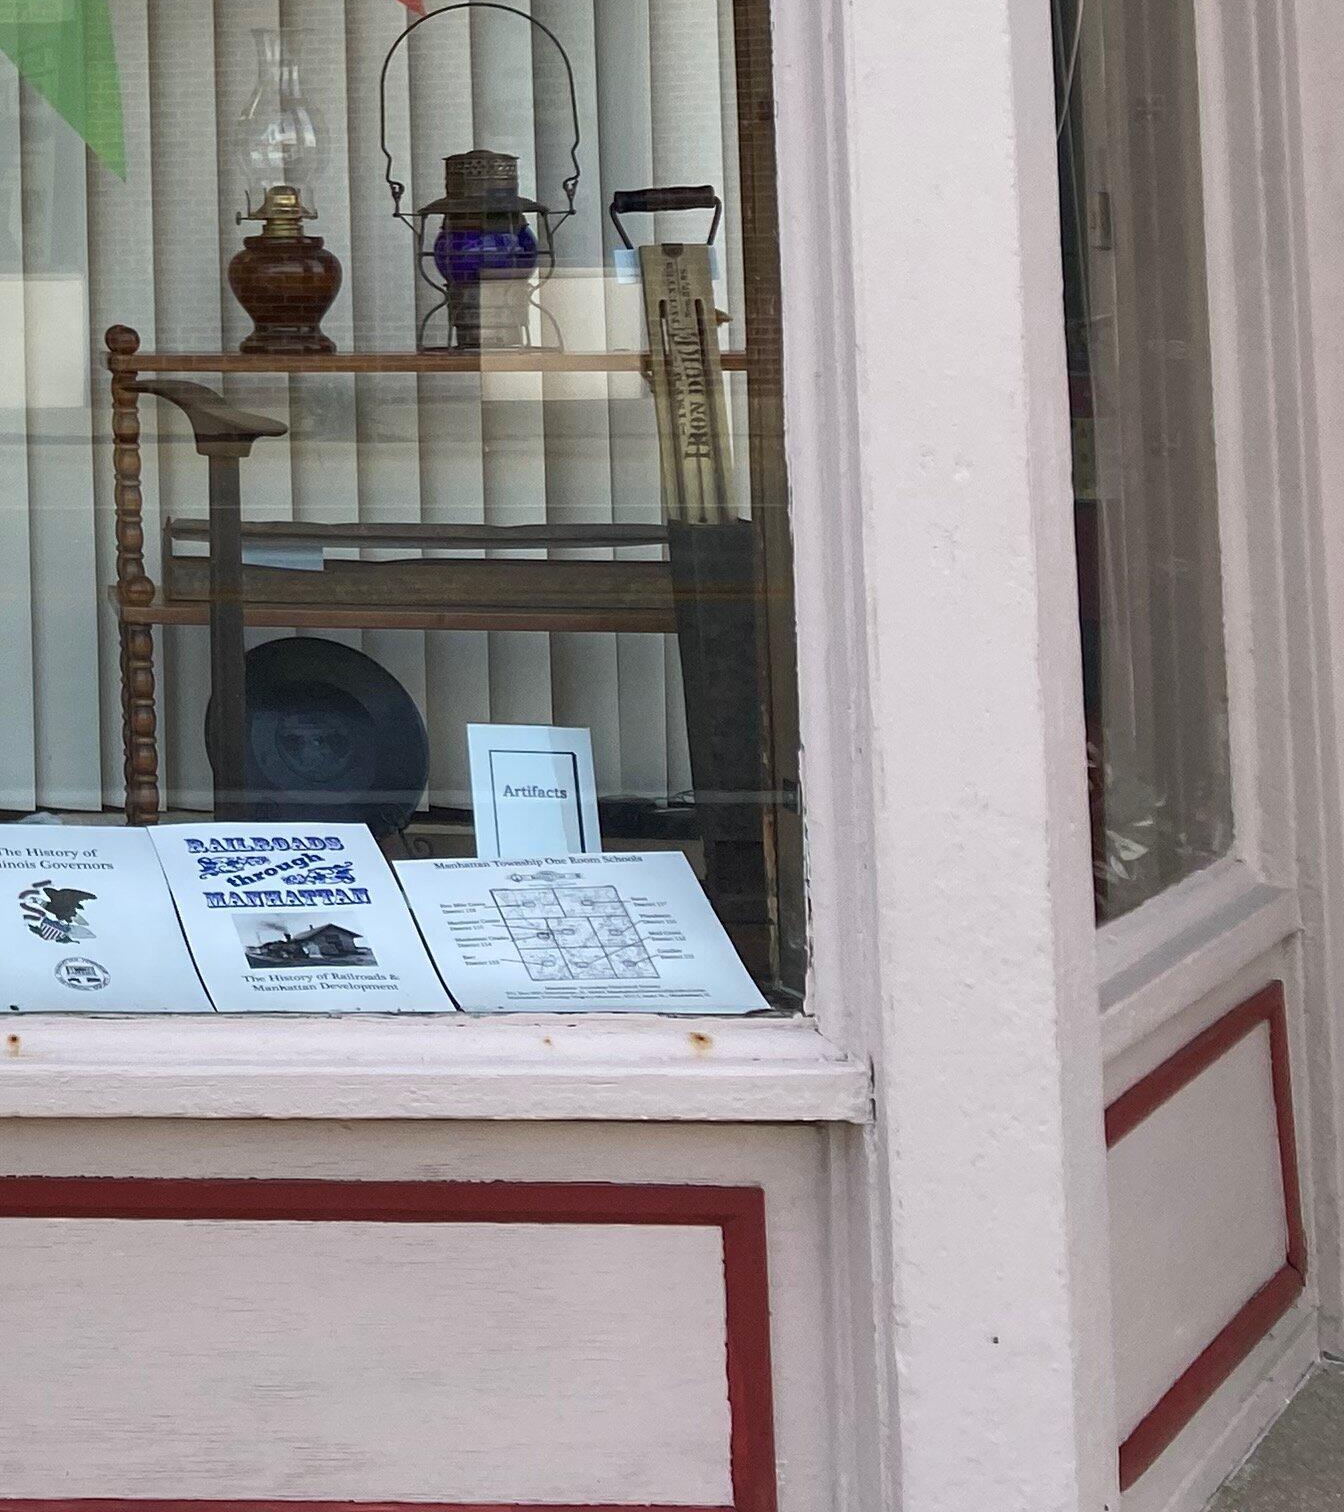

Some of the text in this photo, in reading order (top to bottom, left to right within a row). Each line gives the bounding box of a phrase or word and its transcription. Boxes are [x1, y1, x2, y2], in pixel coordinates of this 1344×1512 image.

[503, 785, 567, 799] Artifacts
[184, 836, 345, 854] RAILROADS
[26, 848, 78, 859] History
[83, 849, 98, 858] of
[40, 860, 114, 870] Governors
[434, 855, 643, 870] Manhattan Township One Room Schools
[226, 852, 325, 888] through
[202, 888, 372, 909] MANHATTAN
[242, 975, 266, 983] The
[269, 974, 314, 984] History
[316, 972, 331, 981] of
[331, 972, 387, 981] Railroads
[253, 982, 399, 992] Manhattan Development
